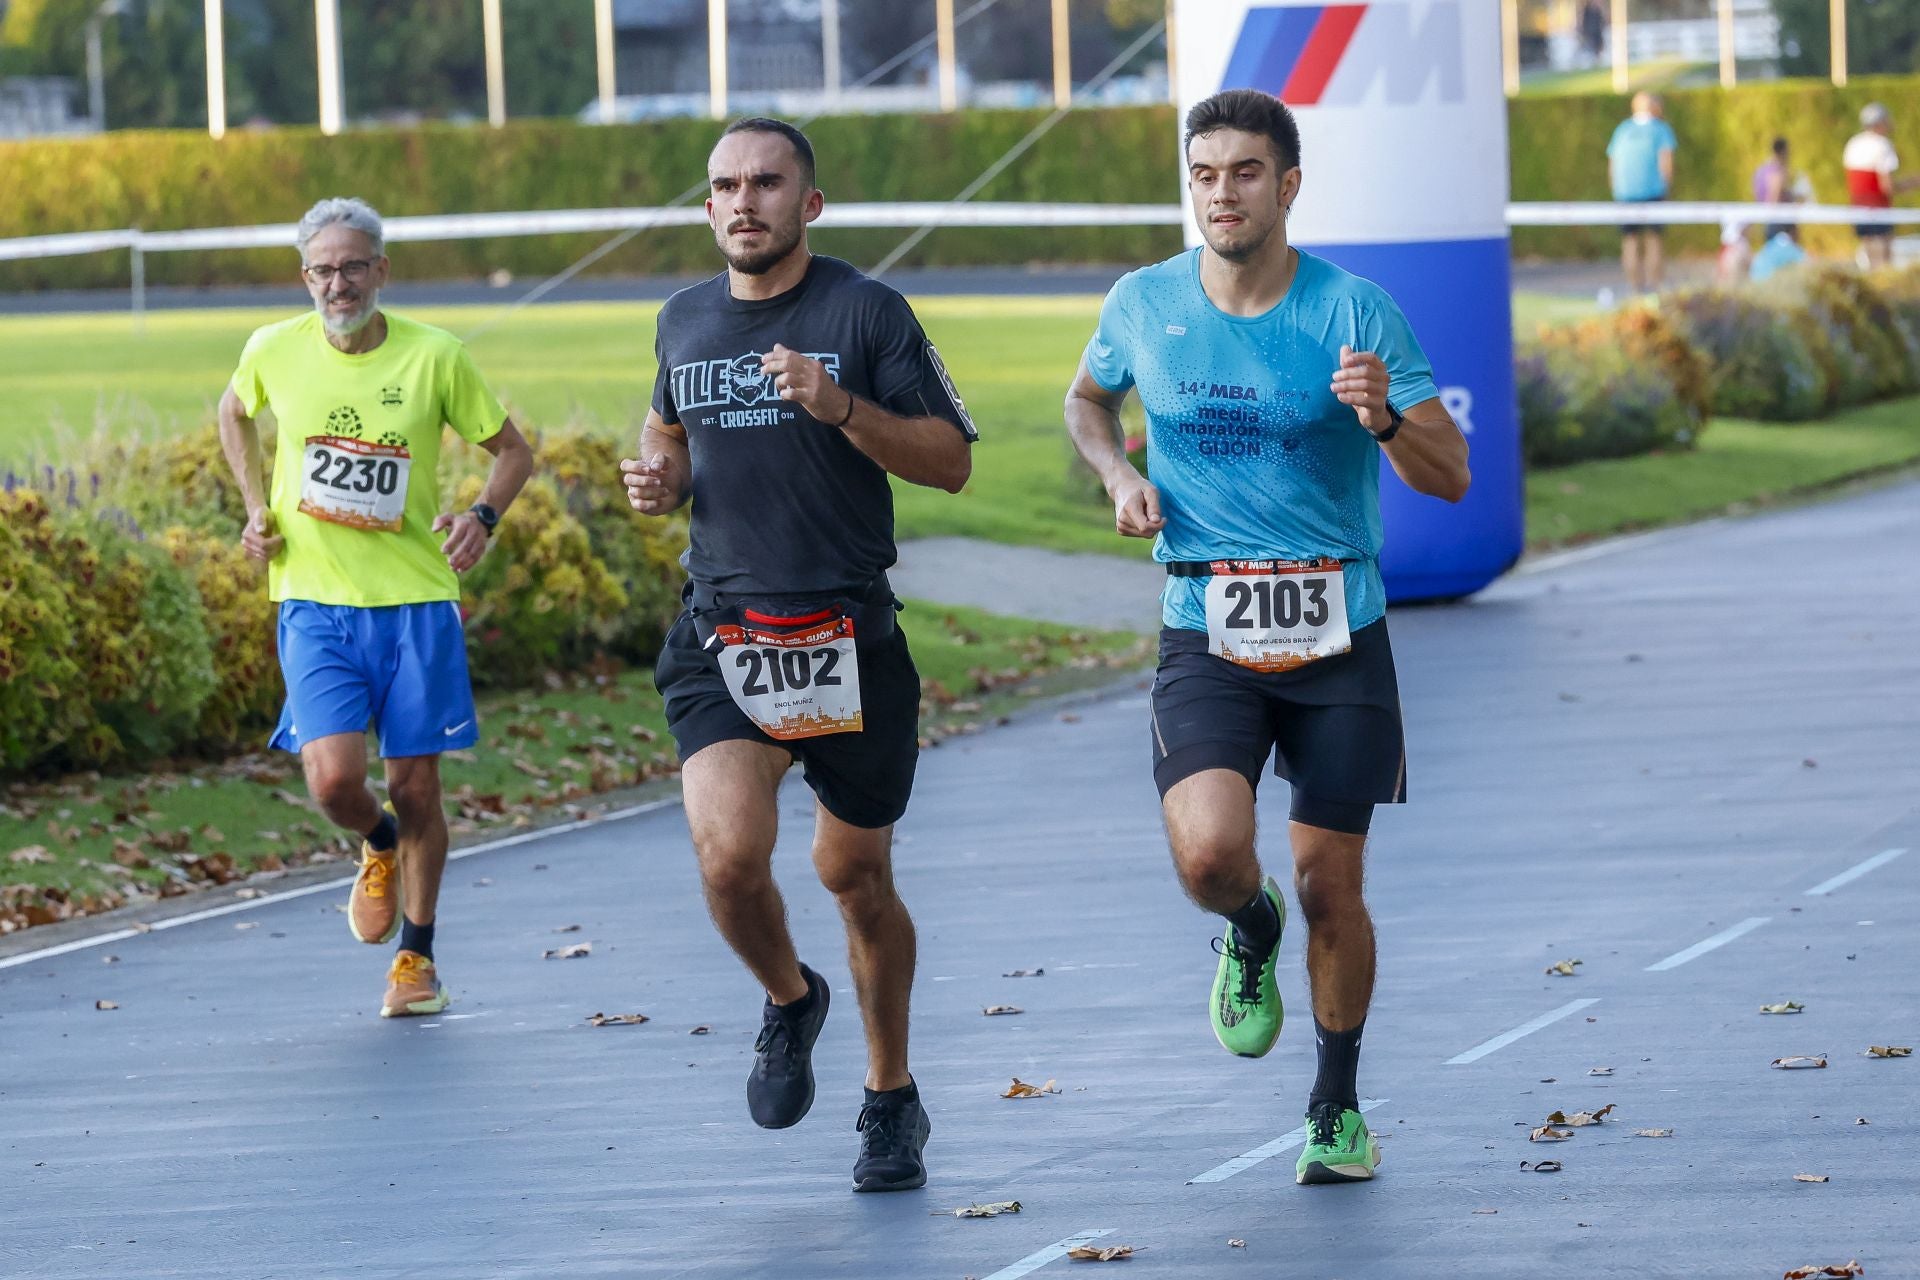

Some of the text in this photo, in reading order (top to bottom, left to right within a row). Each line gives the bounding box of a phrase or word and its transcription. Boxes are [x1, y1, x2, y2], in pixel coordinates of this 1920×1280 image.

[1208, 383, 1258, 401] MBA
[702, 417, 718, 425] EST.
[719, 408, 779, 429] CROSSFIT
[1198, 406, 1260, 423] media
[311, 449, 398, 495] 2230
[1224, 578, 1328, 629] 2103
[1293, 635, 1317, 644] BRAÑA
[736, 647, 841, 697] 2102
